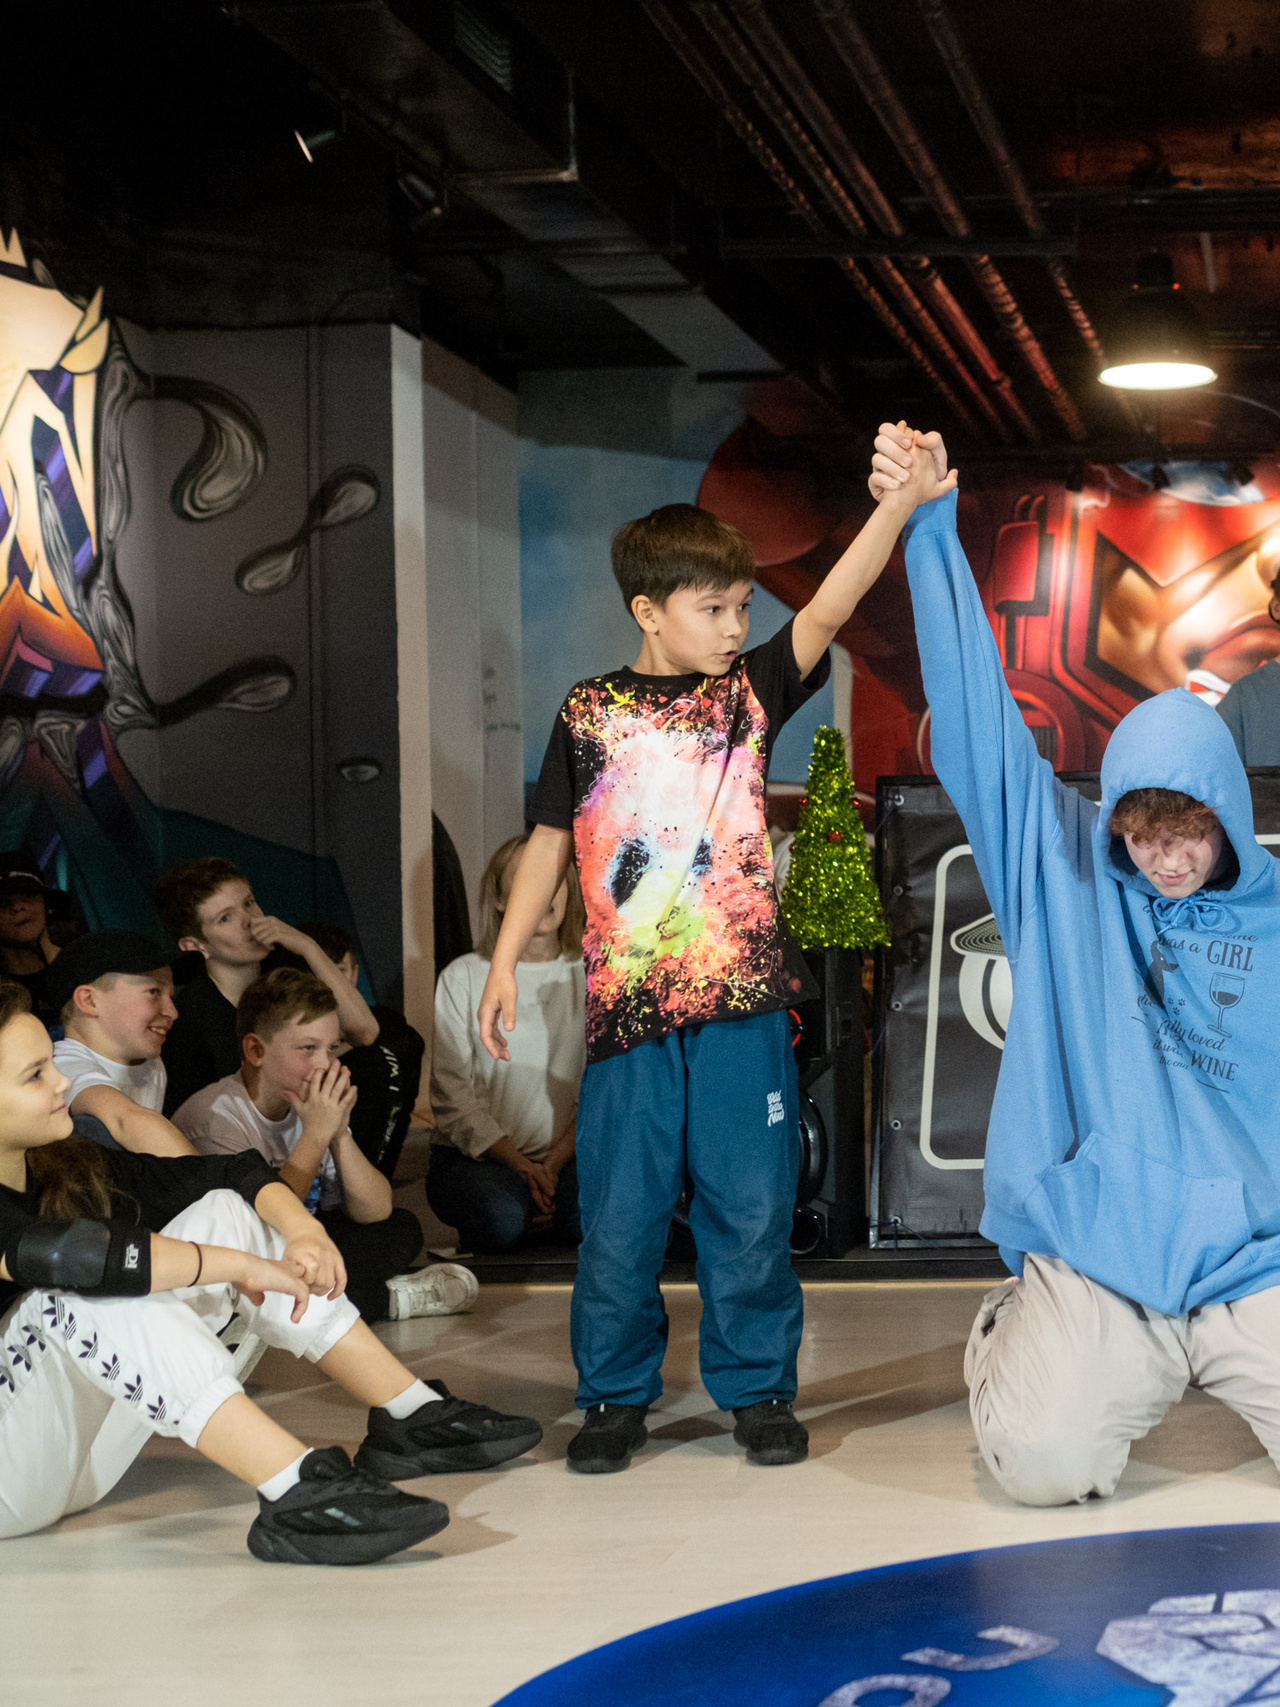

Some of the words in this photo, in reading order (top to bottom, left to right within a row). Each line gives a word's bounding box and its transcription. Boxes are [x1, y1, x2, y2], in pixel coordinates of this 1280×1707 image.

[1206, 939, 1254, 972] GIRL
[1187, 1027, 1226, 1051] loved
[1190, 1050, 1239, 1082] WINE
